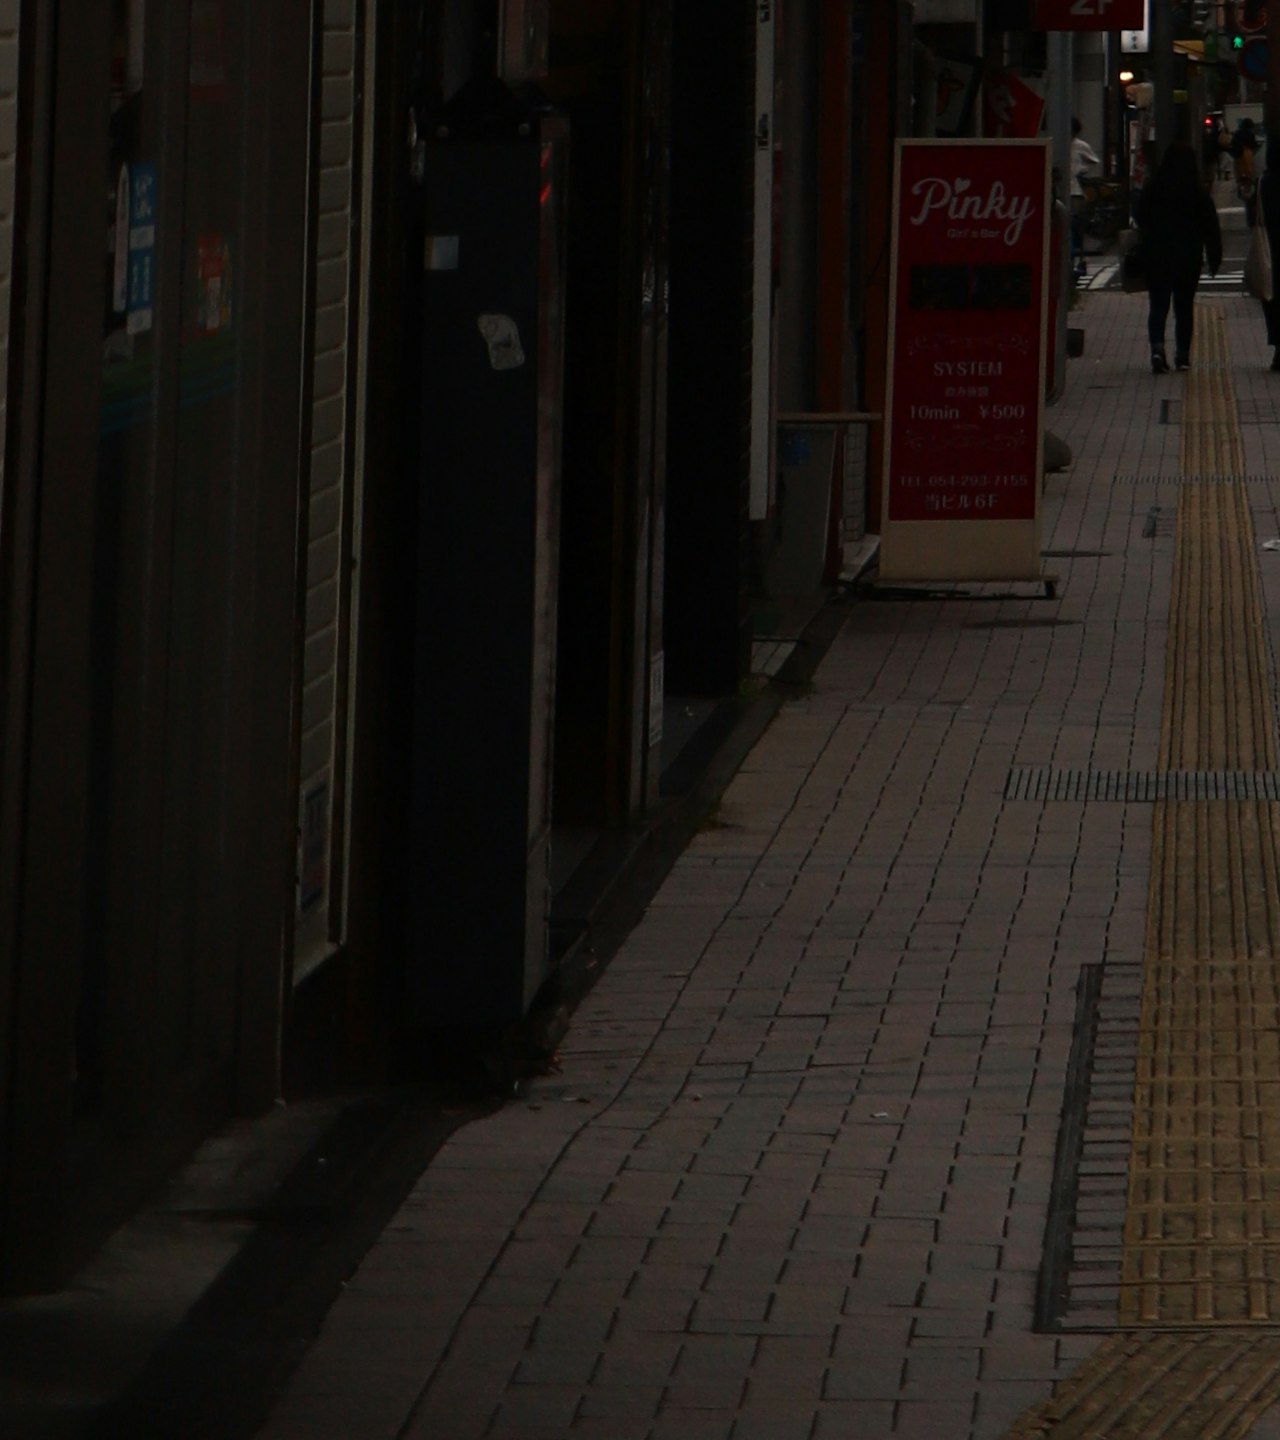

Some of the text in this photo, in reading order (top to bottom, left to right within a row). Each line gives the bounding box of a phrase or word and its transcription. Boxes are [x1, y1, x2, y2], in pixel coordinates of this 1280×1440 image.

[909, 176, 1036, 247] Pinky
[933, 360, 1003, 378] SYSTEM
[909, 404, 960, 421] 10min
